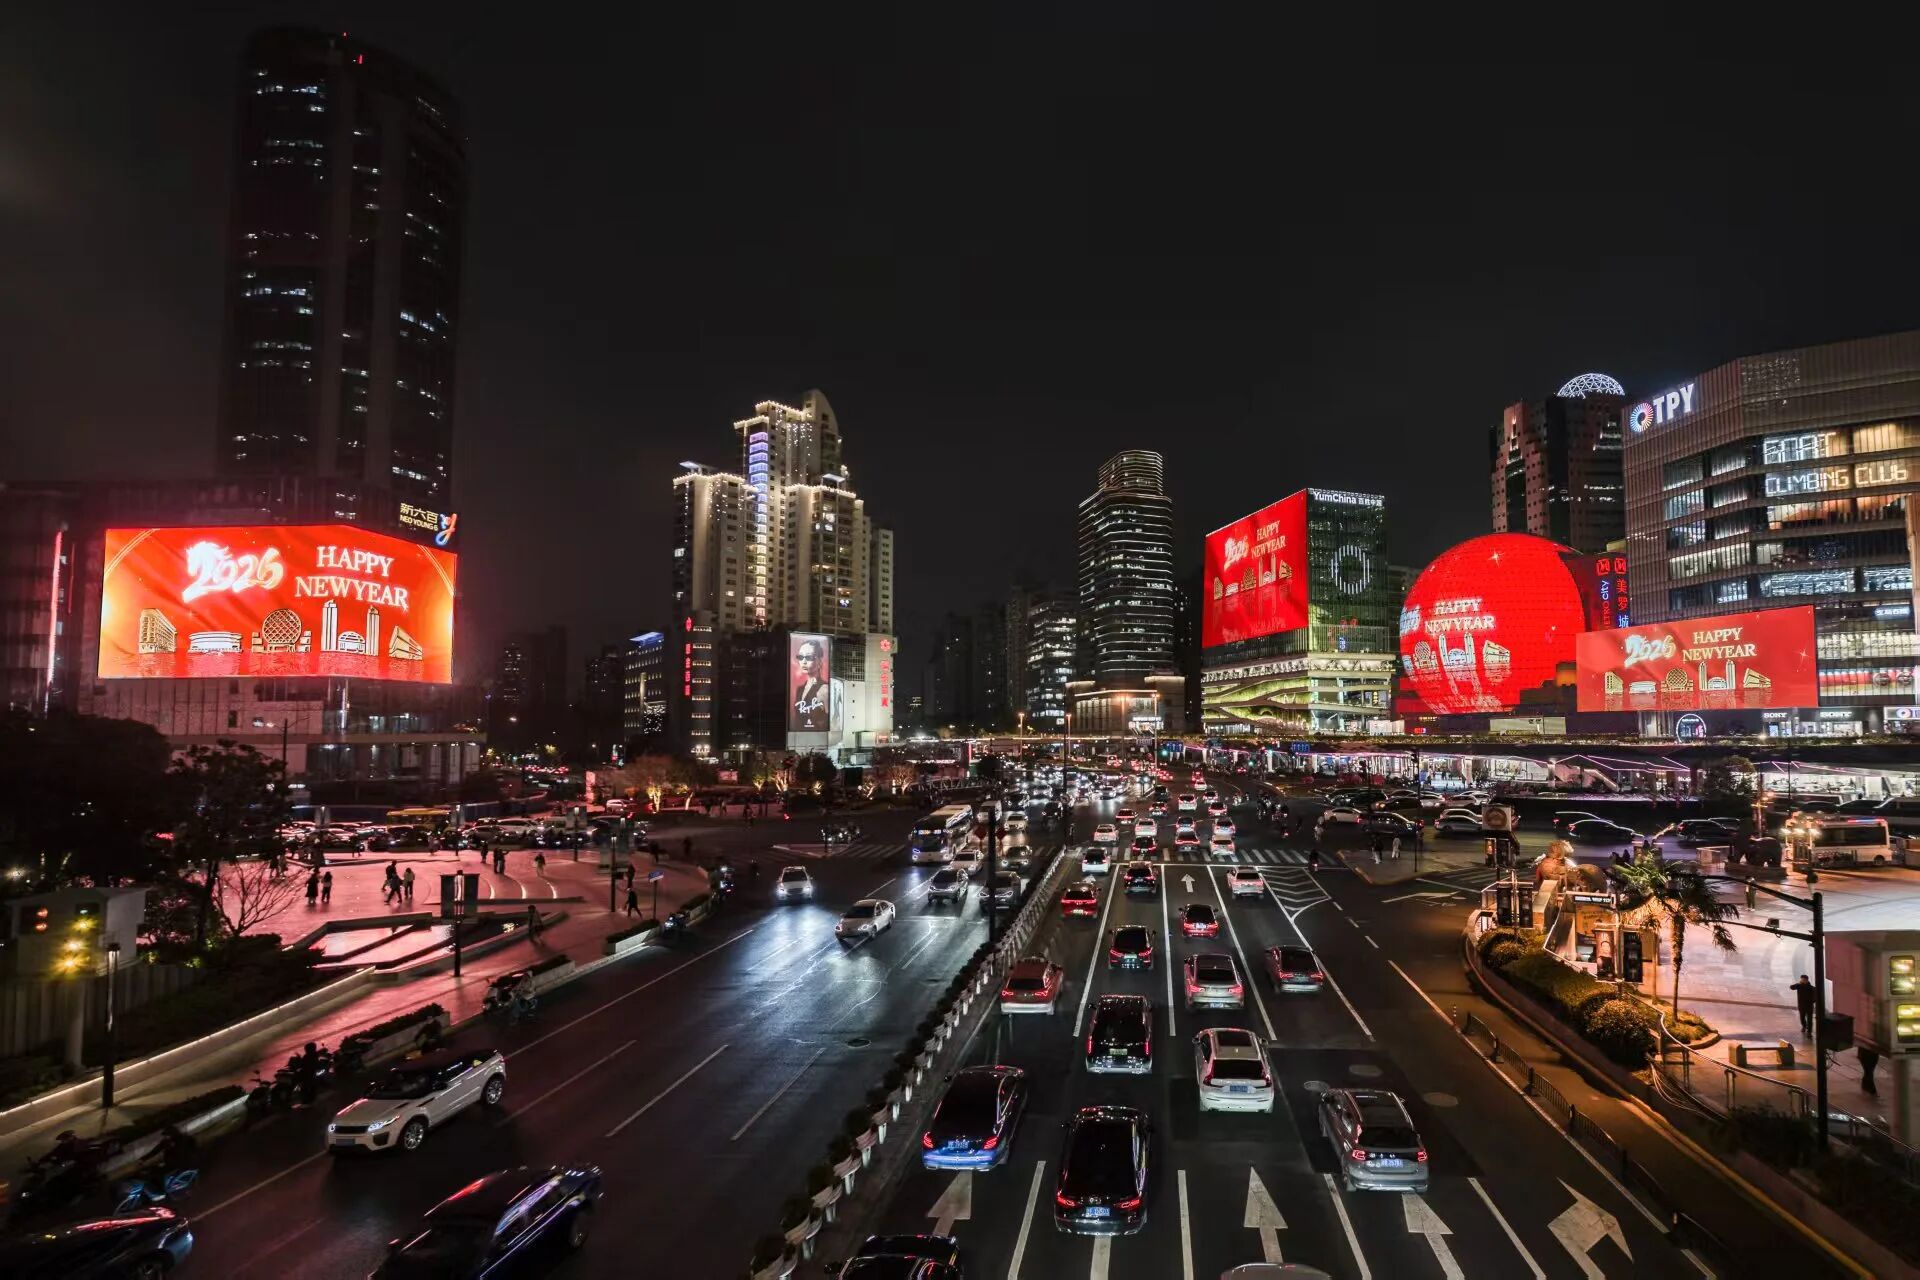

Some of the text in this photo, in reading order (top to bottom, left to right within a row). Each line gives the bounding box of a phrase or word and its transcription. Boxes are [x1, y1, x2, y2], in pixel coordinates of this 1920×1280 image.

[1653, 383, 1695, 424] TPY
[1765, 469, 1849, 494] CLIMBING
[400, 502, 439, 524] 新六百
[400, 514, 413, 524] NEO
[412, 518, 434, 530] YOUNG
[1256, 520, 1281, 541] HAPPY
[181, 540, 285, 604] 2026
[316, 545, 395, 578] HAPPY
[1434, 598, 1483, 615] HAPPY
[1616, 578, 1630, 628] 美罗城
[1692, 627, 1743, 644] HAPPY
[1623, 634, 1677, 668] 2026
